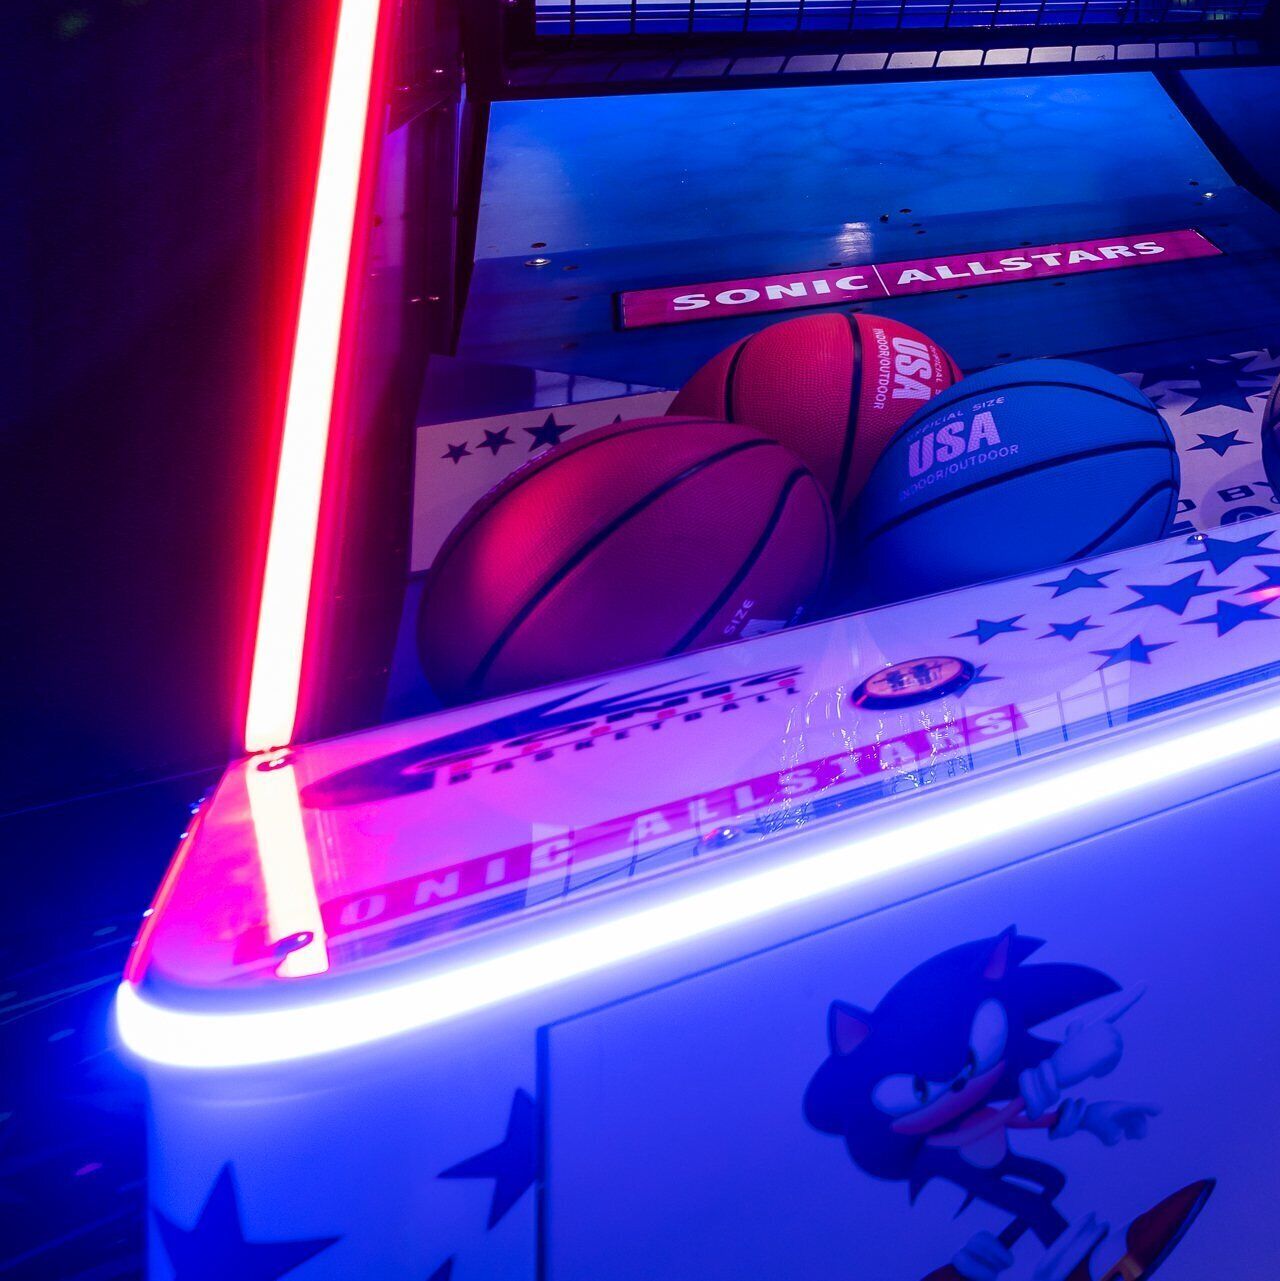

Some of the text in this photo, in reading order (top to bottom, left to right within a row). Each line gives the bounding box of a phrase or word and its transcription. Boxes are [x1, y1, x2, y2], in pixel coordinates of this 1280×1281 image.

[673, 240, 1165, 311] SONIC ALLSTARS
[872, 328, 891, 410] INDOOR/OUTDOOR
[891, 337, 932, 401] USA
[972, 396, 1006, 412] SIZE
[908, 411, 1001, 478] USA
[723, 599, 756, 635] SIZE
[340, 708, 1013, 926] ONIC ALLSTARS
